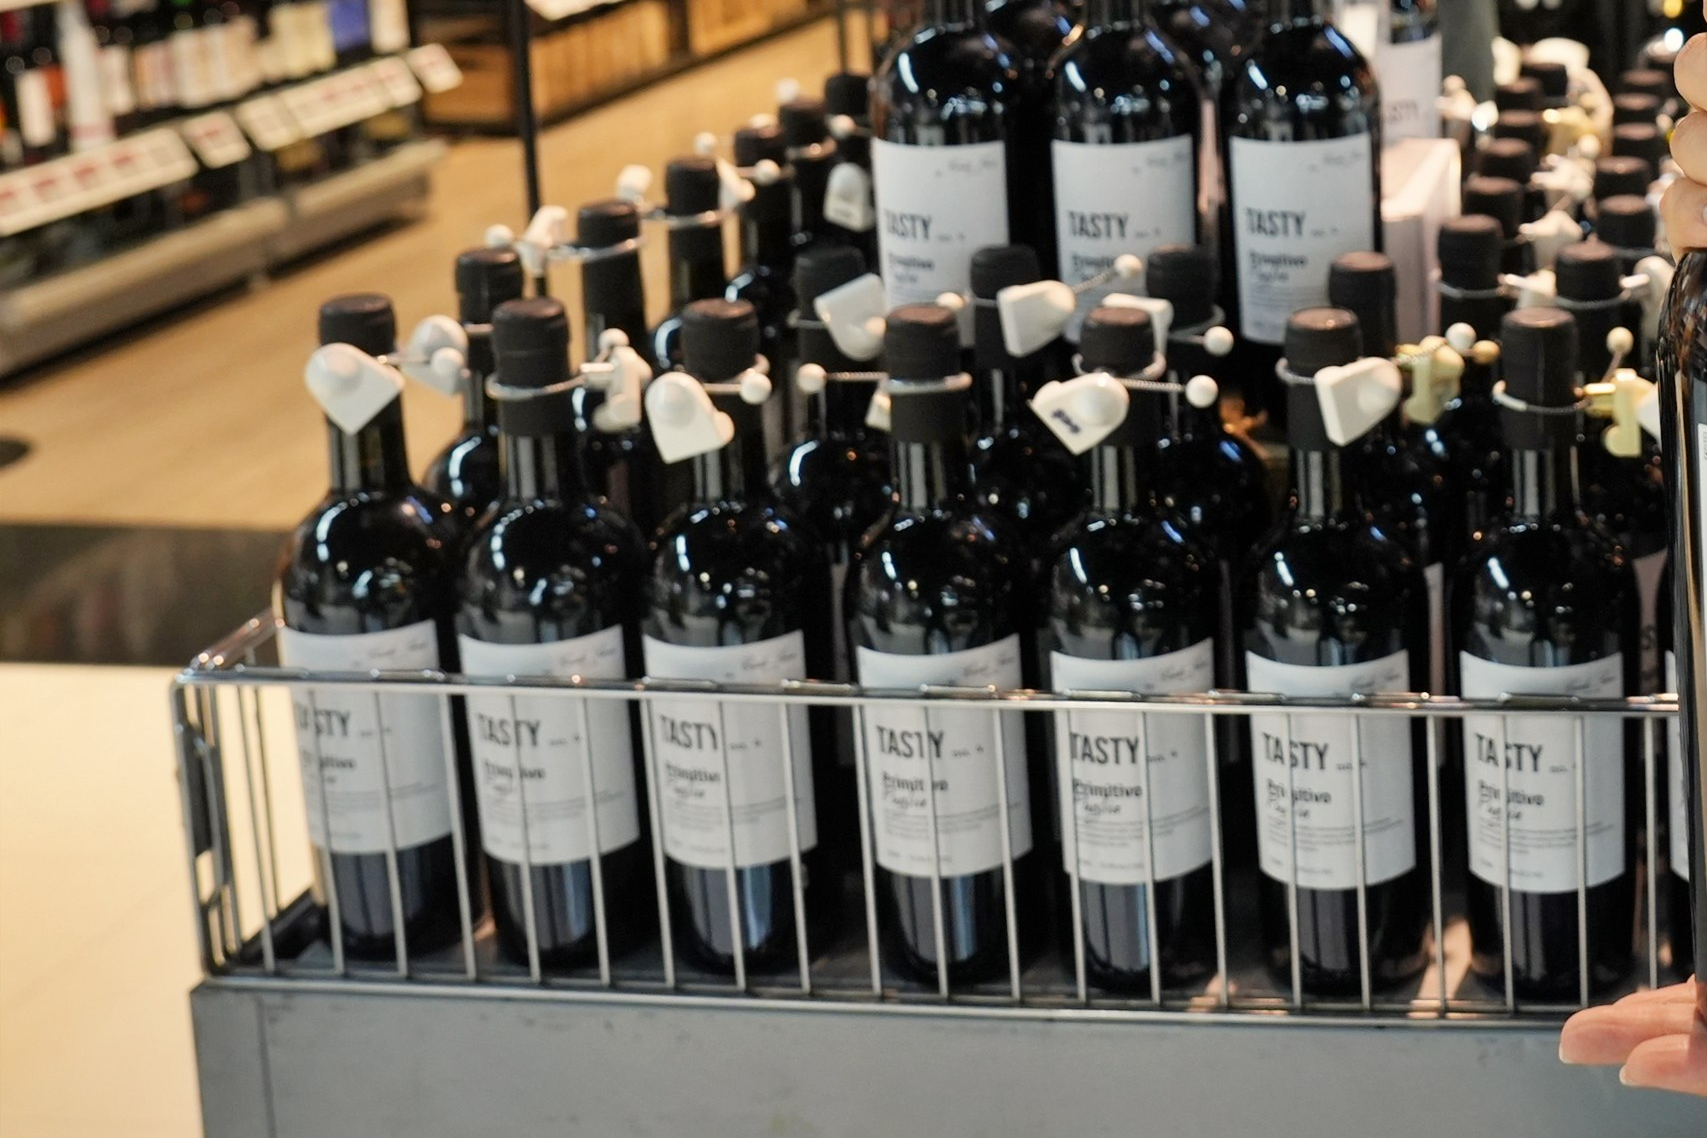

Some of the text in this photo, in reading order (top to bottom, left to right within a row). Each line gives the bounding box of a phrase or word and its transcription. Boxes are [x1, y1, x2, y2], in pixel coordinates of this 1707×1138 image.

[1069, 210, 1129, 239] TASTY
[1245, 206, 1306, 237] TASTY
[1070, 732, 1139, 764] TASTY
